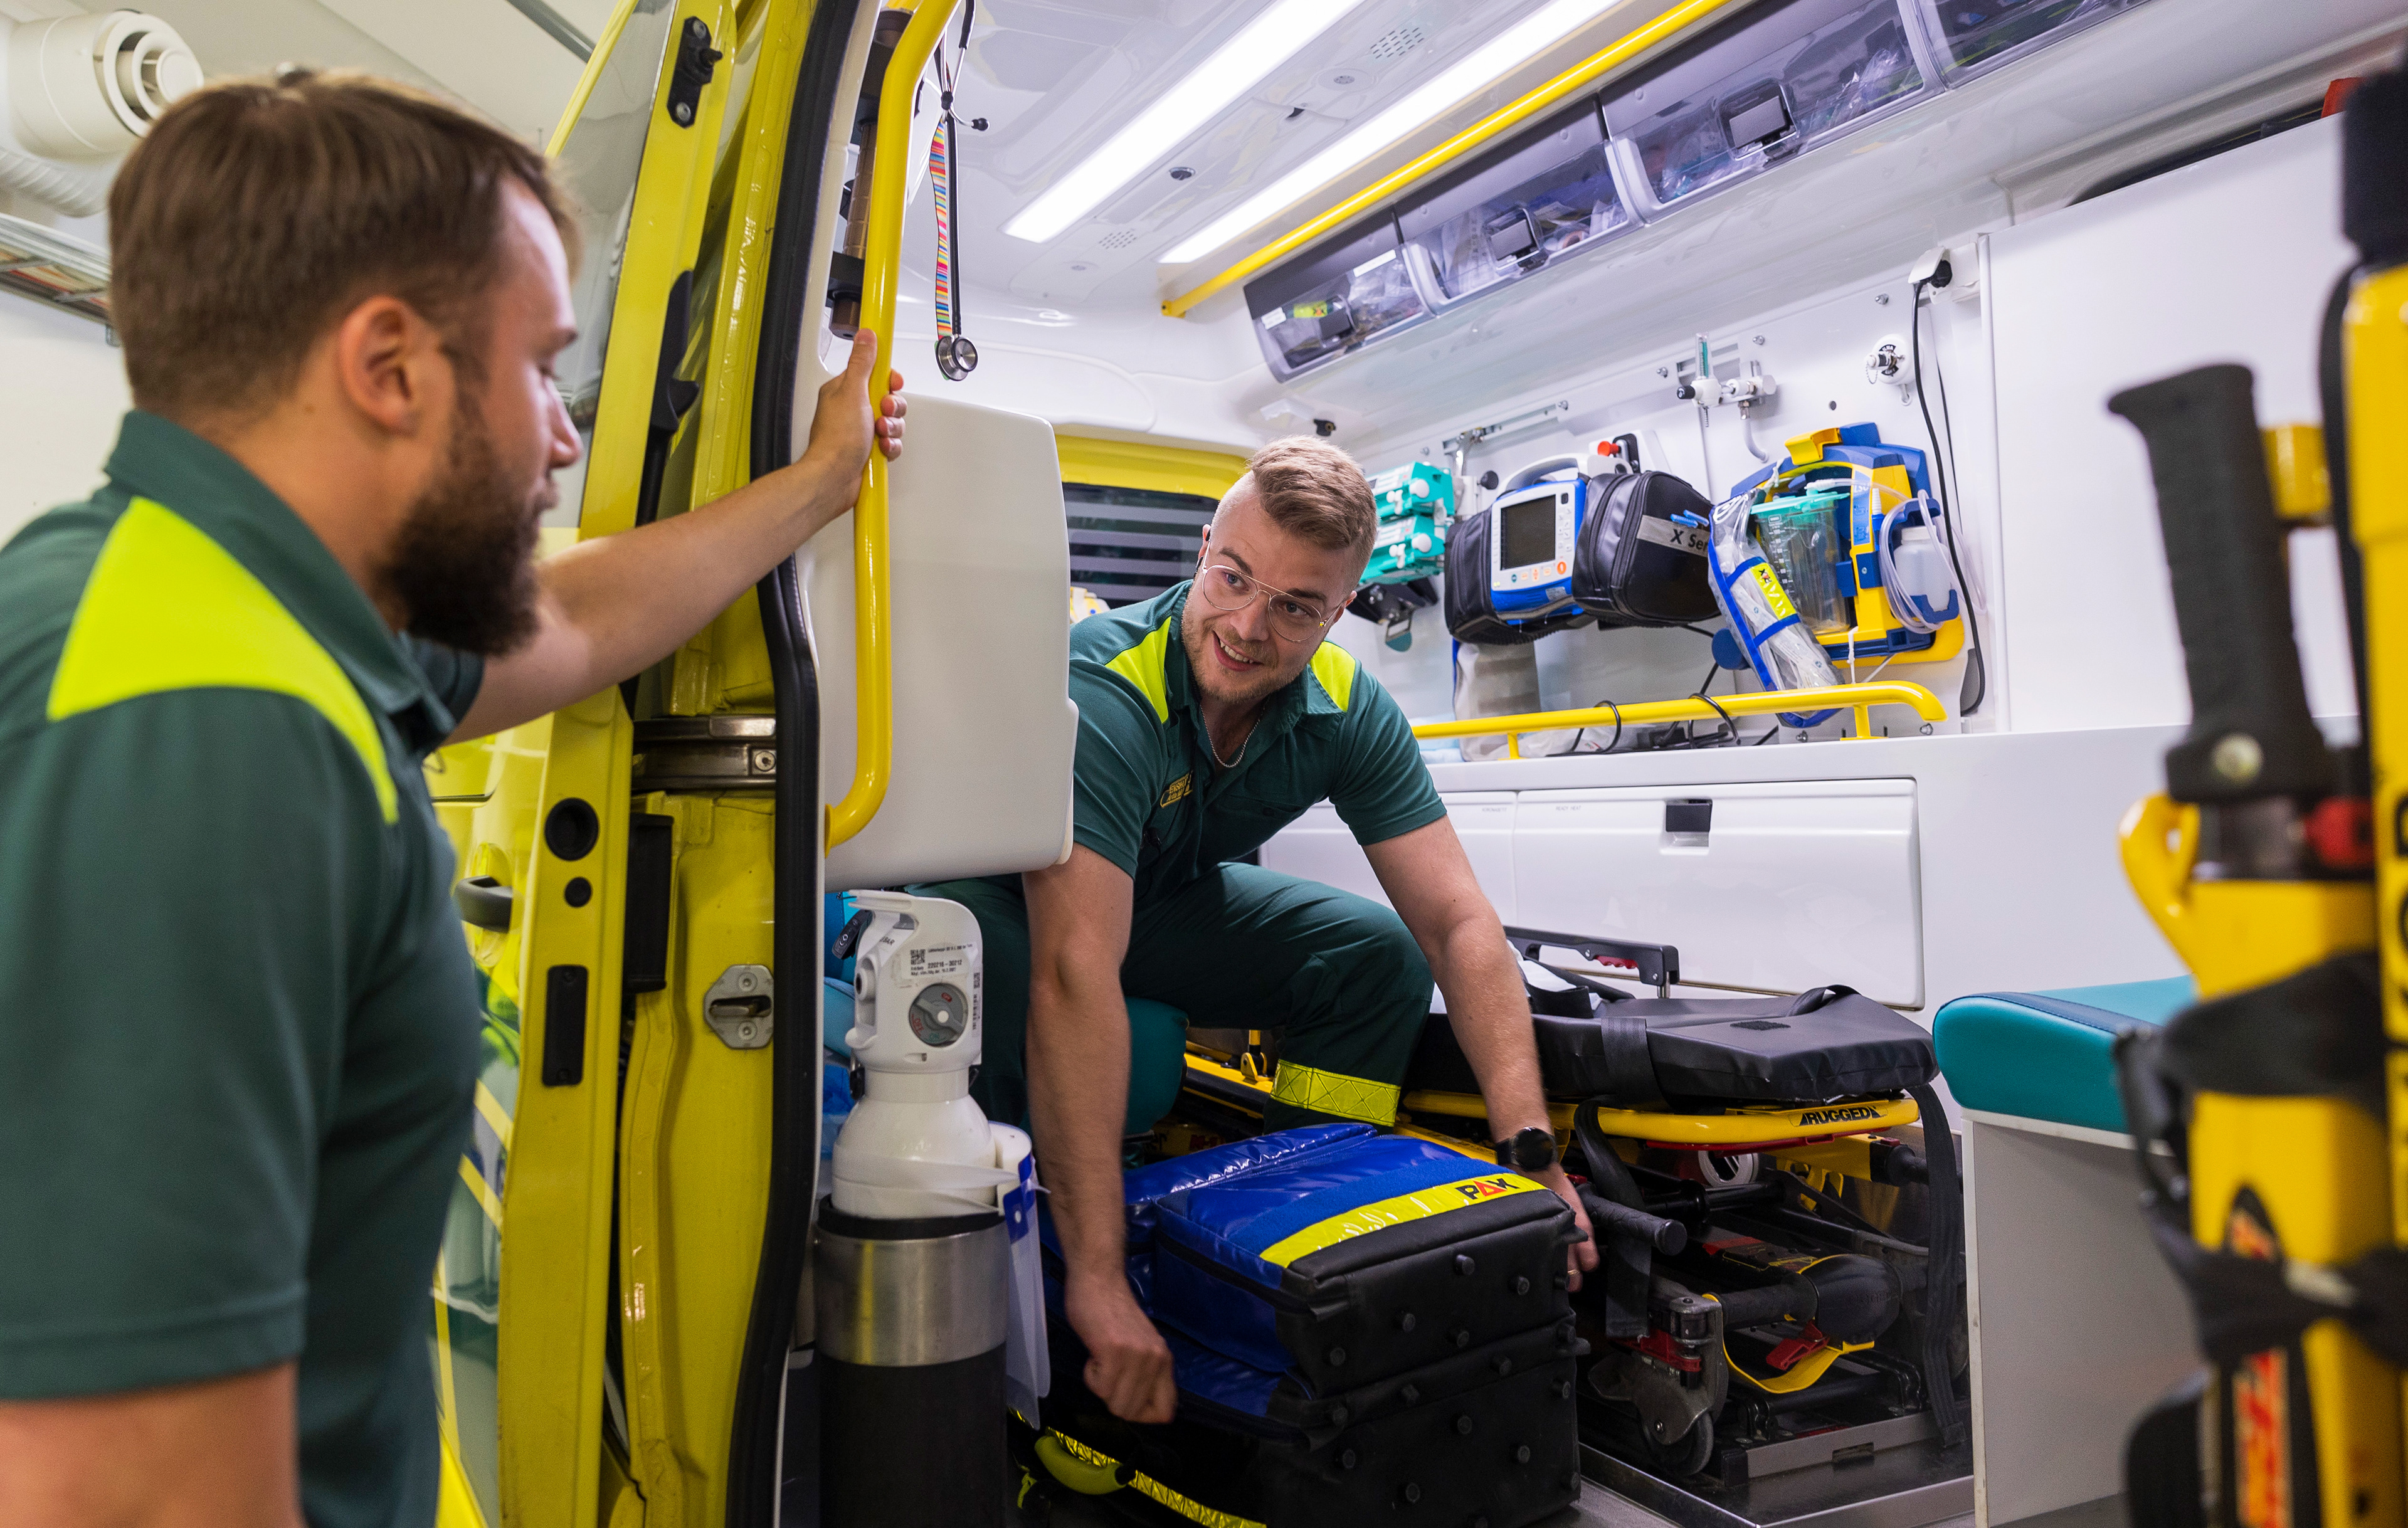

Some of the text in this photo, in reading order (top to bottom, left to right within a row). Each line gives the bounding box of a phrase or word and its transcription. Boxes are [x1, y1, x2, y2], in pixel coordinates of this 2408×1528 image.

[1670, 529, 1708, 551] X Ser
[1804, 1107, 1871, 1125] RUGGED
[1455, 1178, 1521, 1199] PAX
